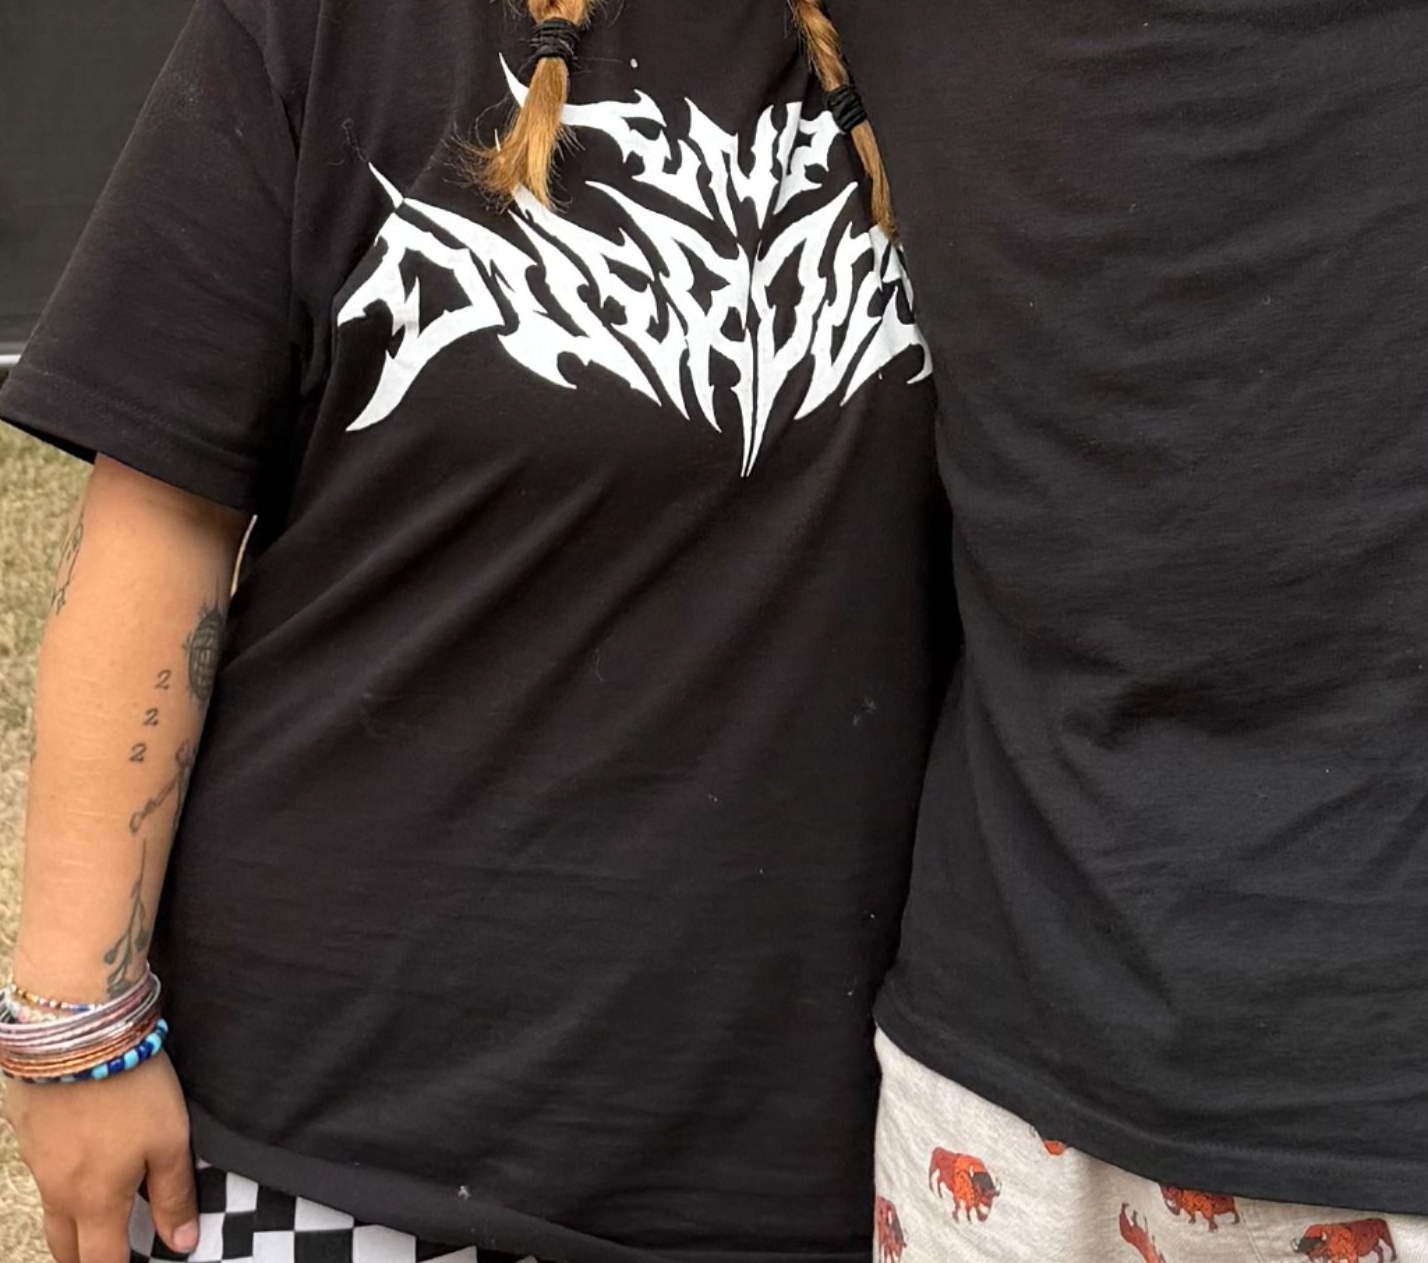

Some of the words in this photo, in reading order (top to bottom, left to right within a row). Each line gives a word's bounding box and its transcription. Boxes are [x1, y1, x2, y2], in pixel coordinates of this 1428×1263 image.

[156, 669, 172, 690] 2
[144, 707, 159, 726] 2
[129, 742, 147, 763] 2
